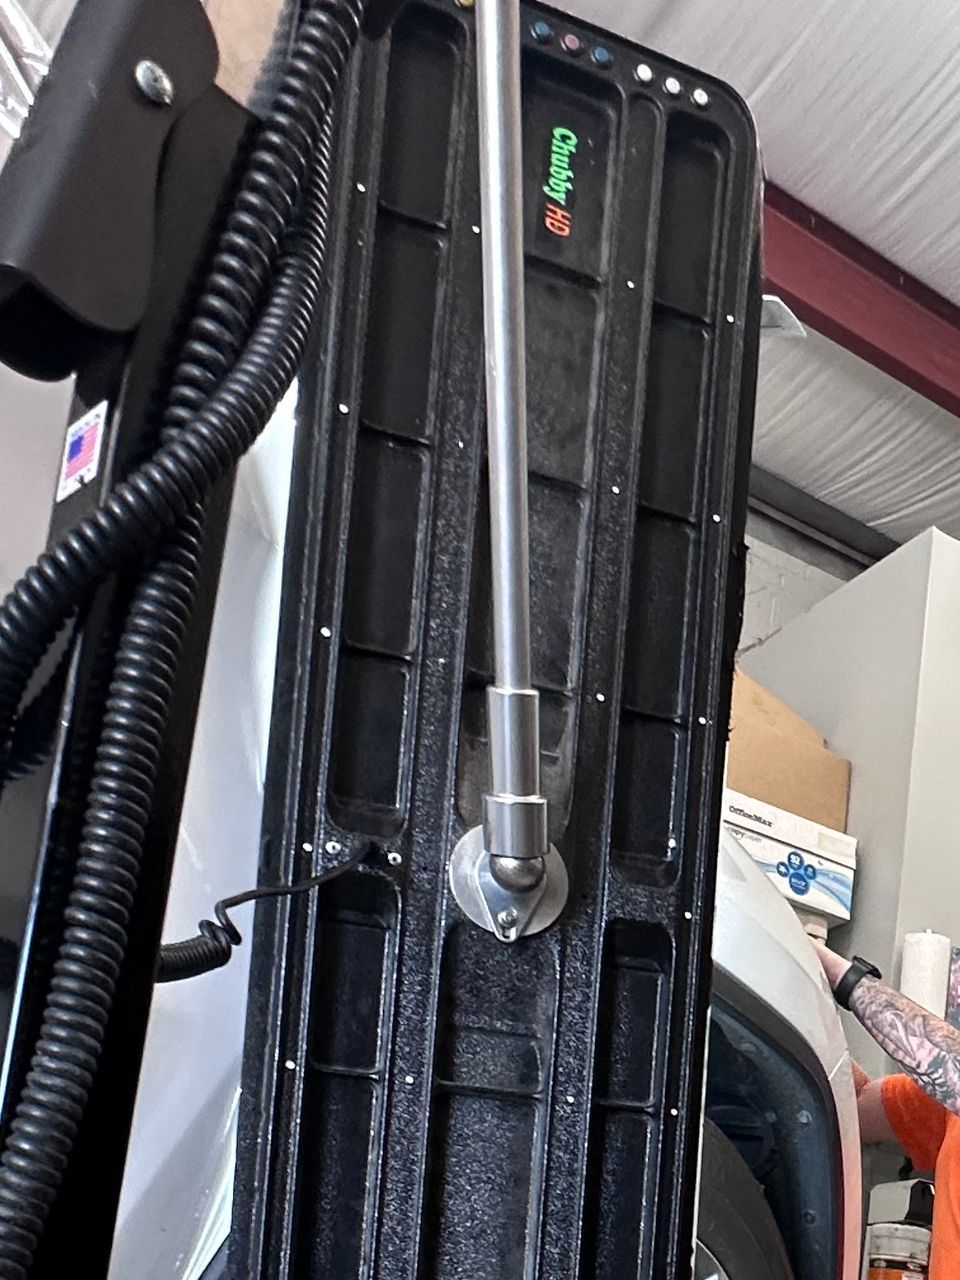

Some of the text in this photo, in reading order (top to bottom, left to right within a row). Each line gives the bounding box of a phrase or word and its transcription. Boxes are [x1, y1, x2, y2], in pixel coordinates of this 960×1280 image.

[543, 127, 578, 237] Chubby HD
[729, 805, 773, 827] OfficeMax
